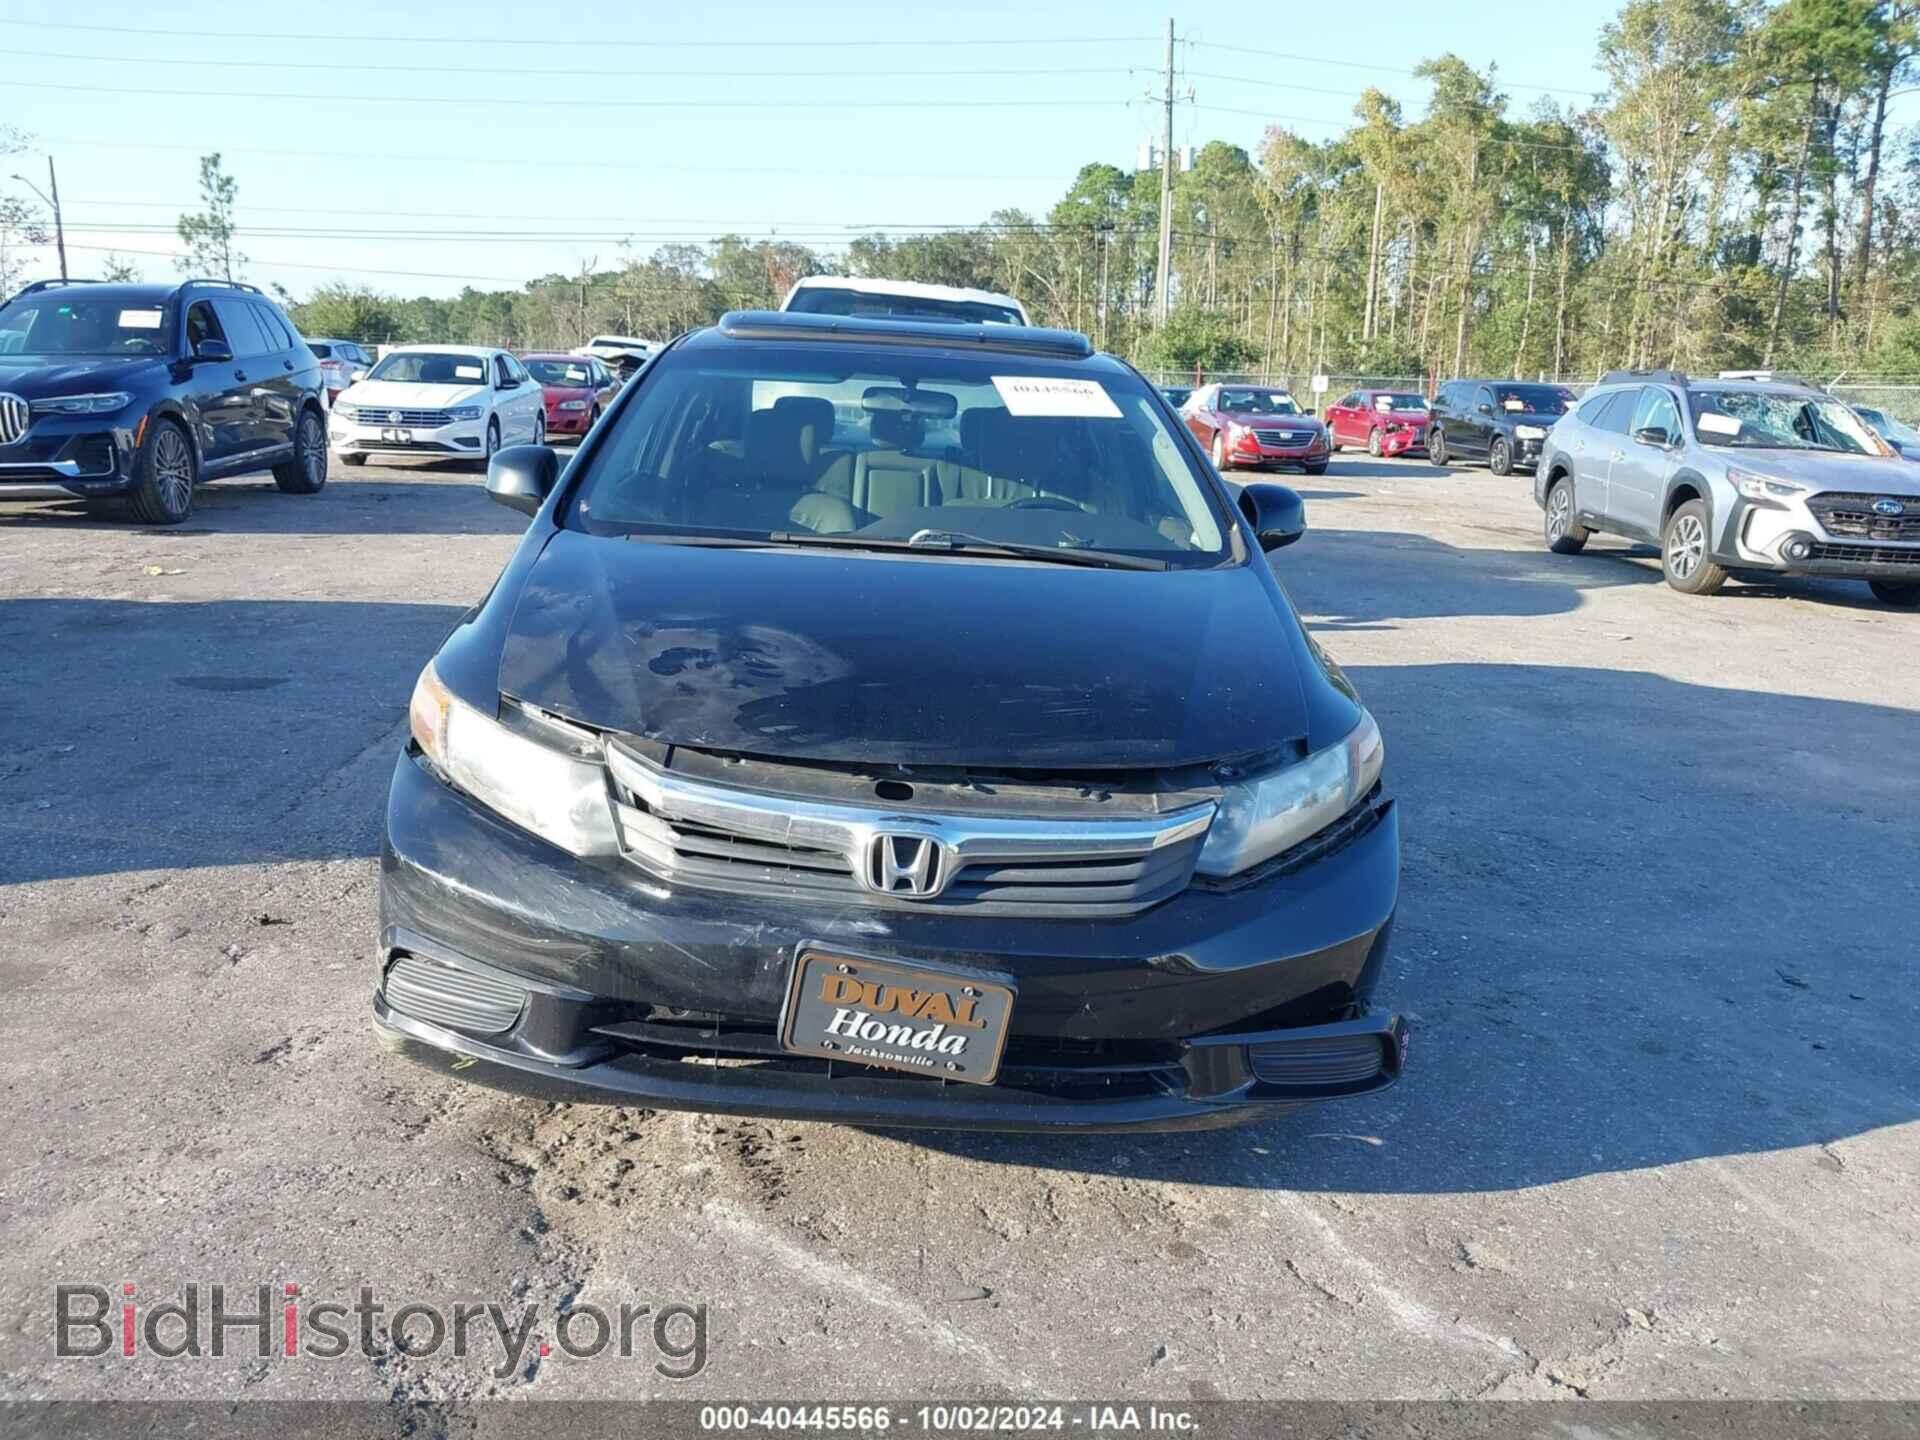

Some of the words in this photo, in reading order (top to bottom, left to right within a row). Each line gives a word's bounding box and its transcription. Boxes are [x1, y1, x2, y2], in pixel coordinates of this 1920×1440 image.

[818, 974, 986, 1029] DUVAL
[824, 1008, 968, 1055] Honda
[845, 1044, 935, 1067] Jacksonville
